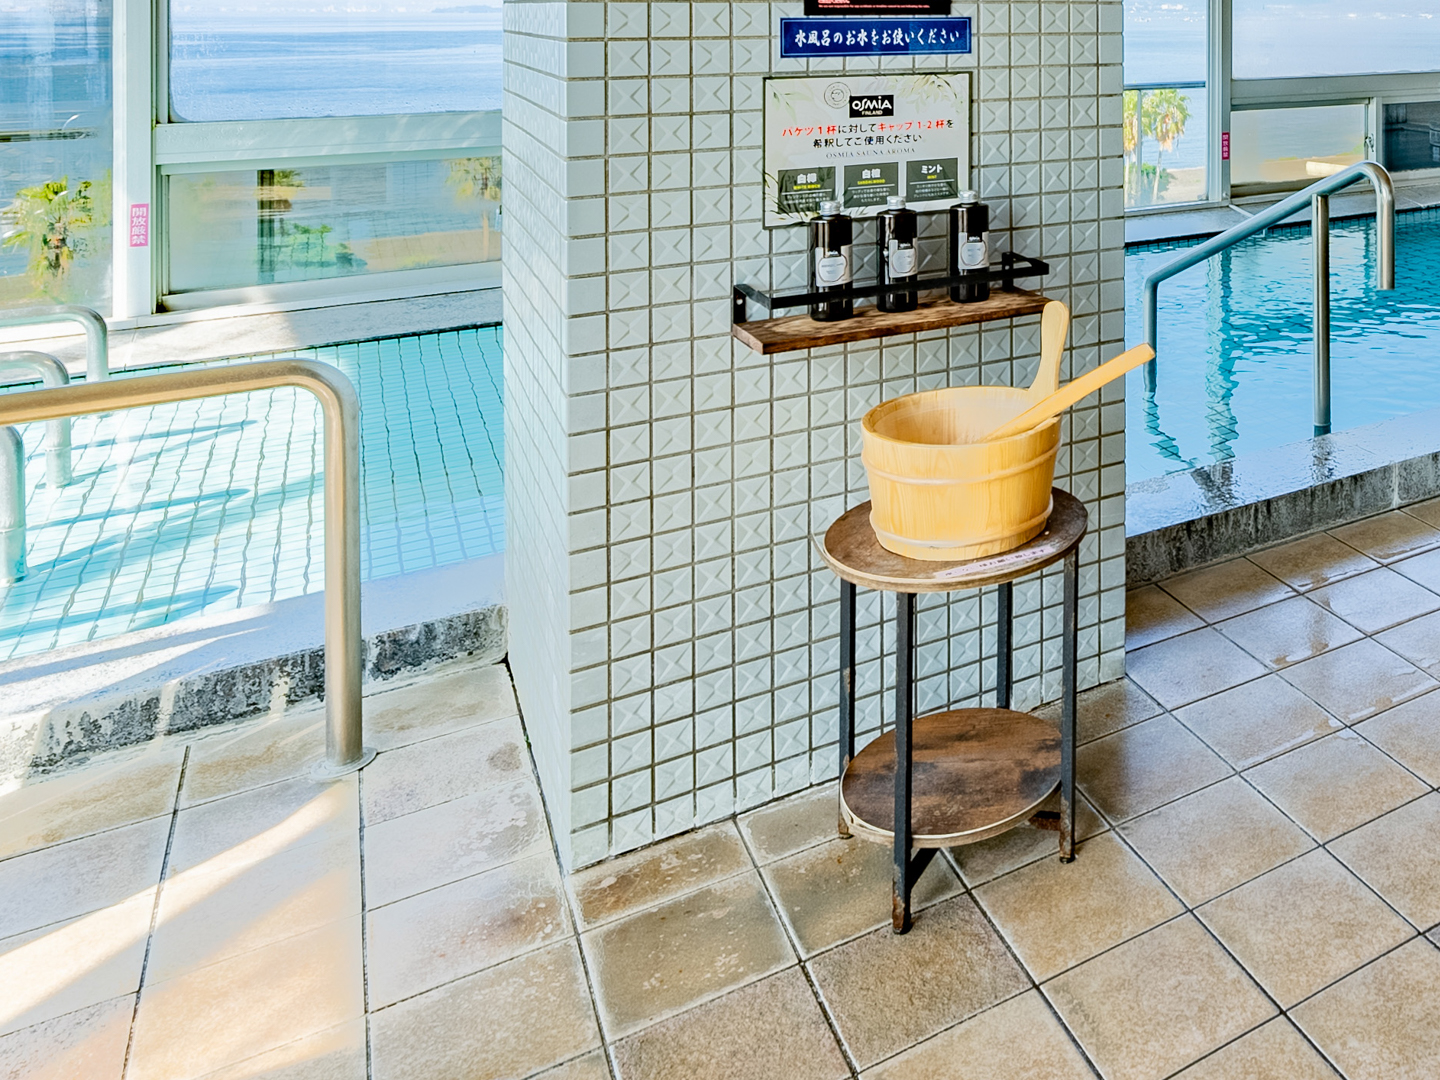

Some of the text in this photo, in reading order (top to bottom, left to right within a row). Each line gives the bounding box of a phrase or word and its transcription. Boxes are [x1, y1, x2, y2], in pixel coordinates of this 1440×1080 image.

[795, 28, 960, 48] 水風呂のお水をお使いください
[825, 151, 854, 159] OSMIA
[921, 164, 943, 175] ミント
[131, 207, 147, 245] 開放厳禁
